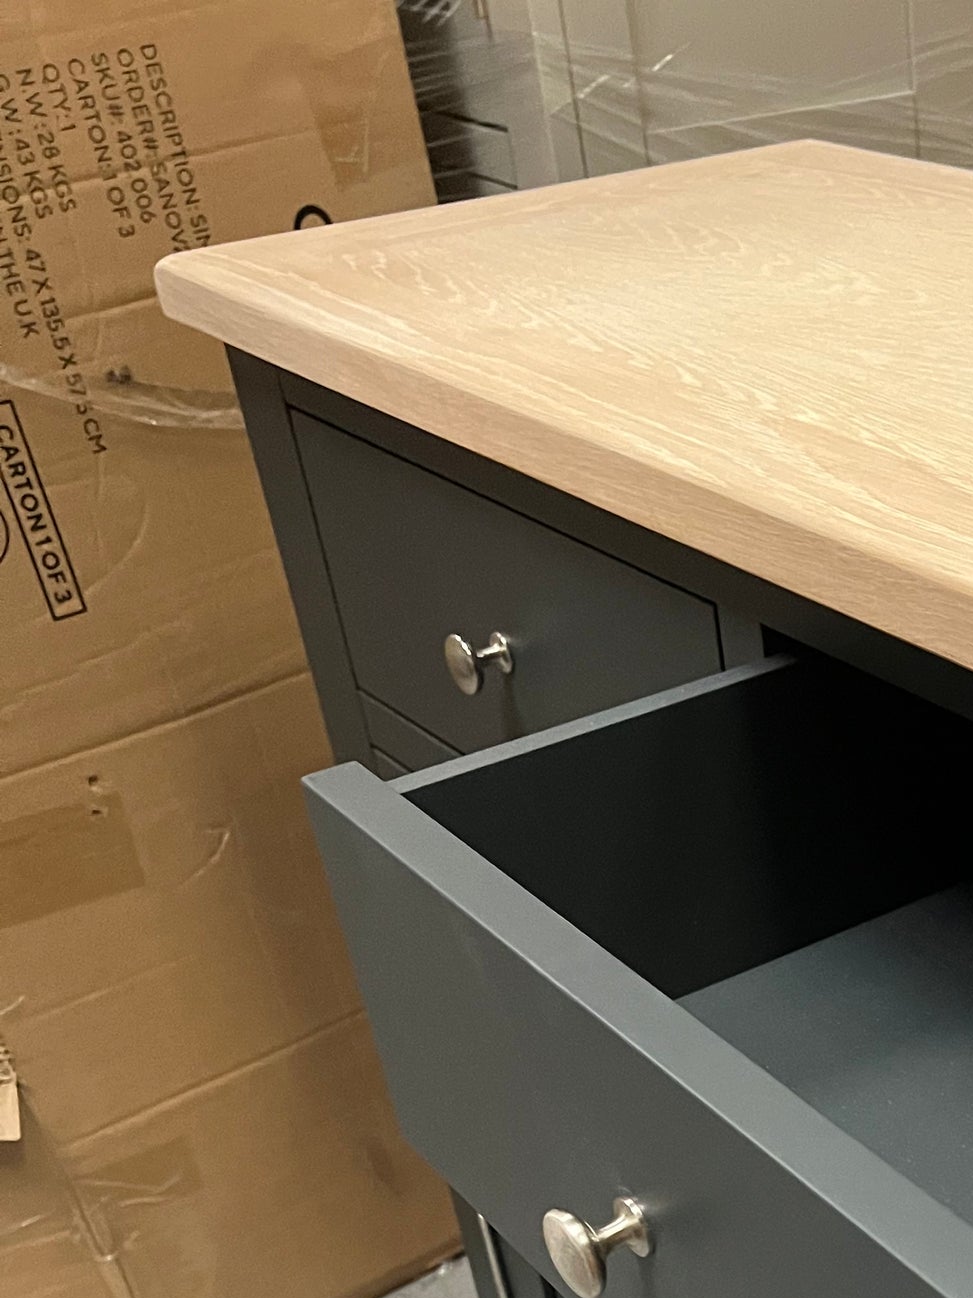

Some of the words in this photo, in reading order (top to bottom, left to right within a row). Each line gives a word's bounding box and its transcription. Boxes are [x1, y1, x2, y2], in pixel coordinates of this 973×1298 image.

[91, 52, 126, 125] SKU#:
[139, 44, 201, 211] DESCRIPTION:
[24, 170, 53, 219] KGS
[48, 164, 77, 213] KGS
[107, 186, 132, 219] OF
[118, 224, 136, 238] 3
[26, 249, 46, 272] 47
[32, 278, 52, 294] X
[41, 298, 71, 350] 135.5
[58, 353, 77, 369] X
[84, 418, 107, 455] CM
[0, 425, 46, 532] CARTON
[35, 535, 52, 546] 1
[42, 551, 67, 584] OF
[54, 589, 72, 605] 3
